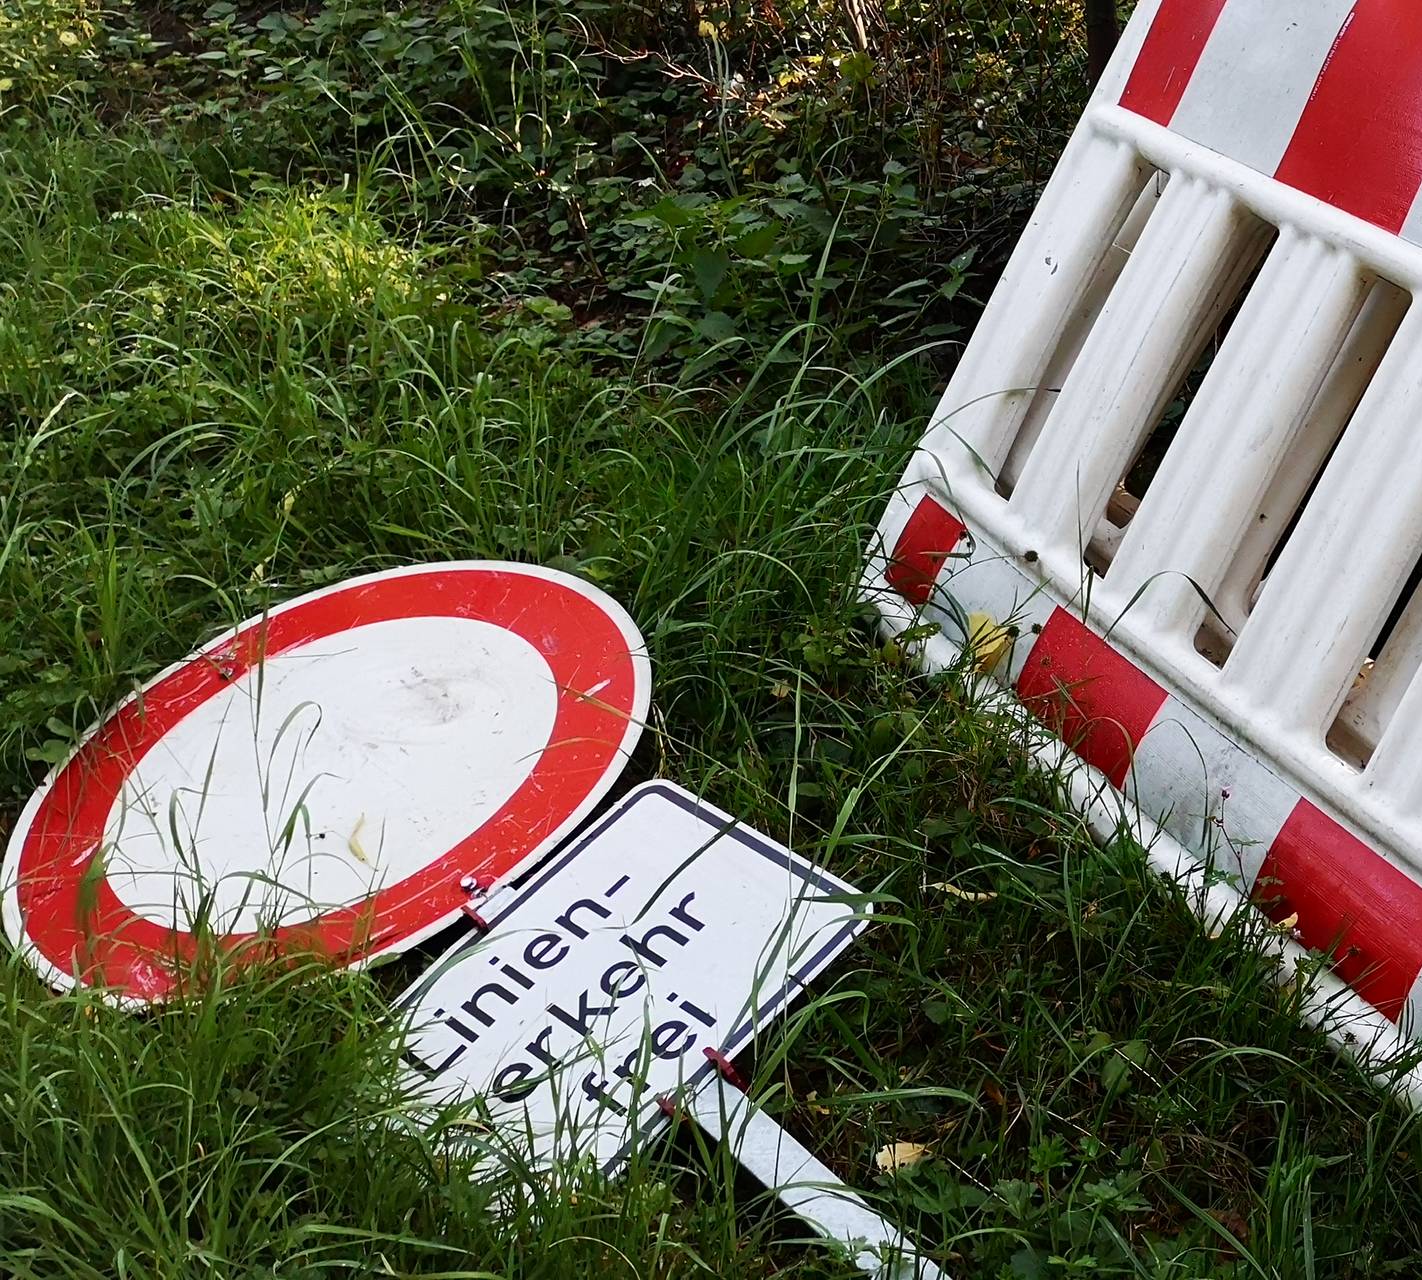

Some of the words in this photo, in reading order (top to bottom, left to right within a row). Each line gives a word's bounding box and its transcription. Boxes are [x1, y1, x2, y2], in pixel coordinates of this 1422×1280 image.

[401, 874, 631, 1081] Linien-
[493, 891, 706, 1103] erkehr
[581, 991, 717, 1116] frei
